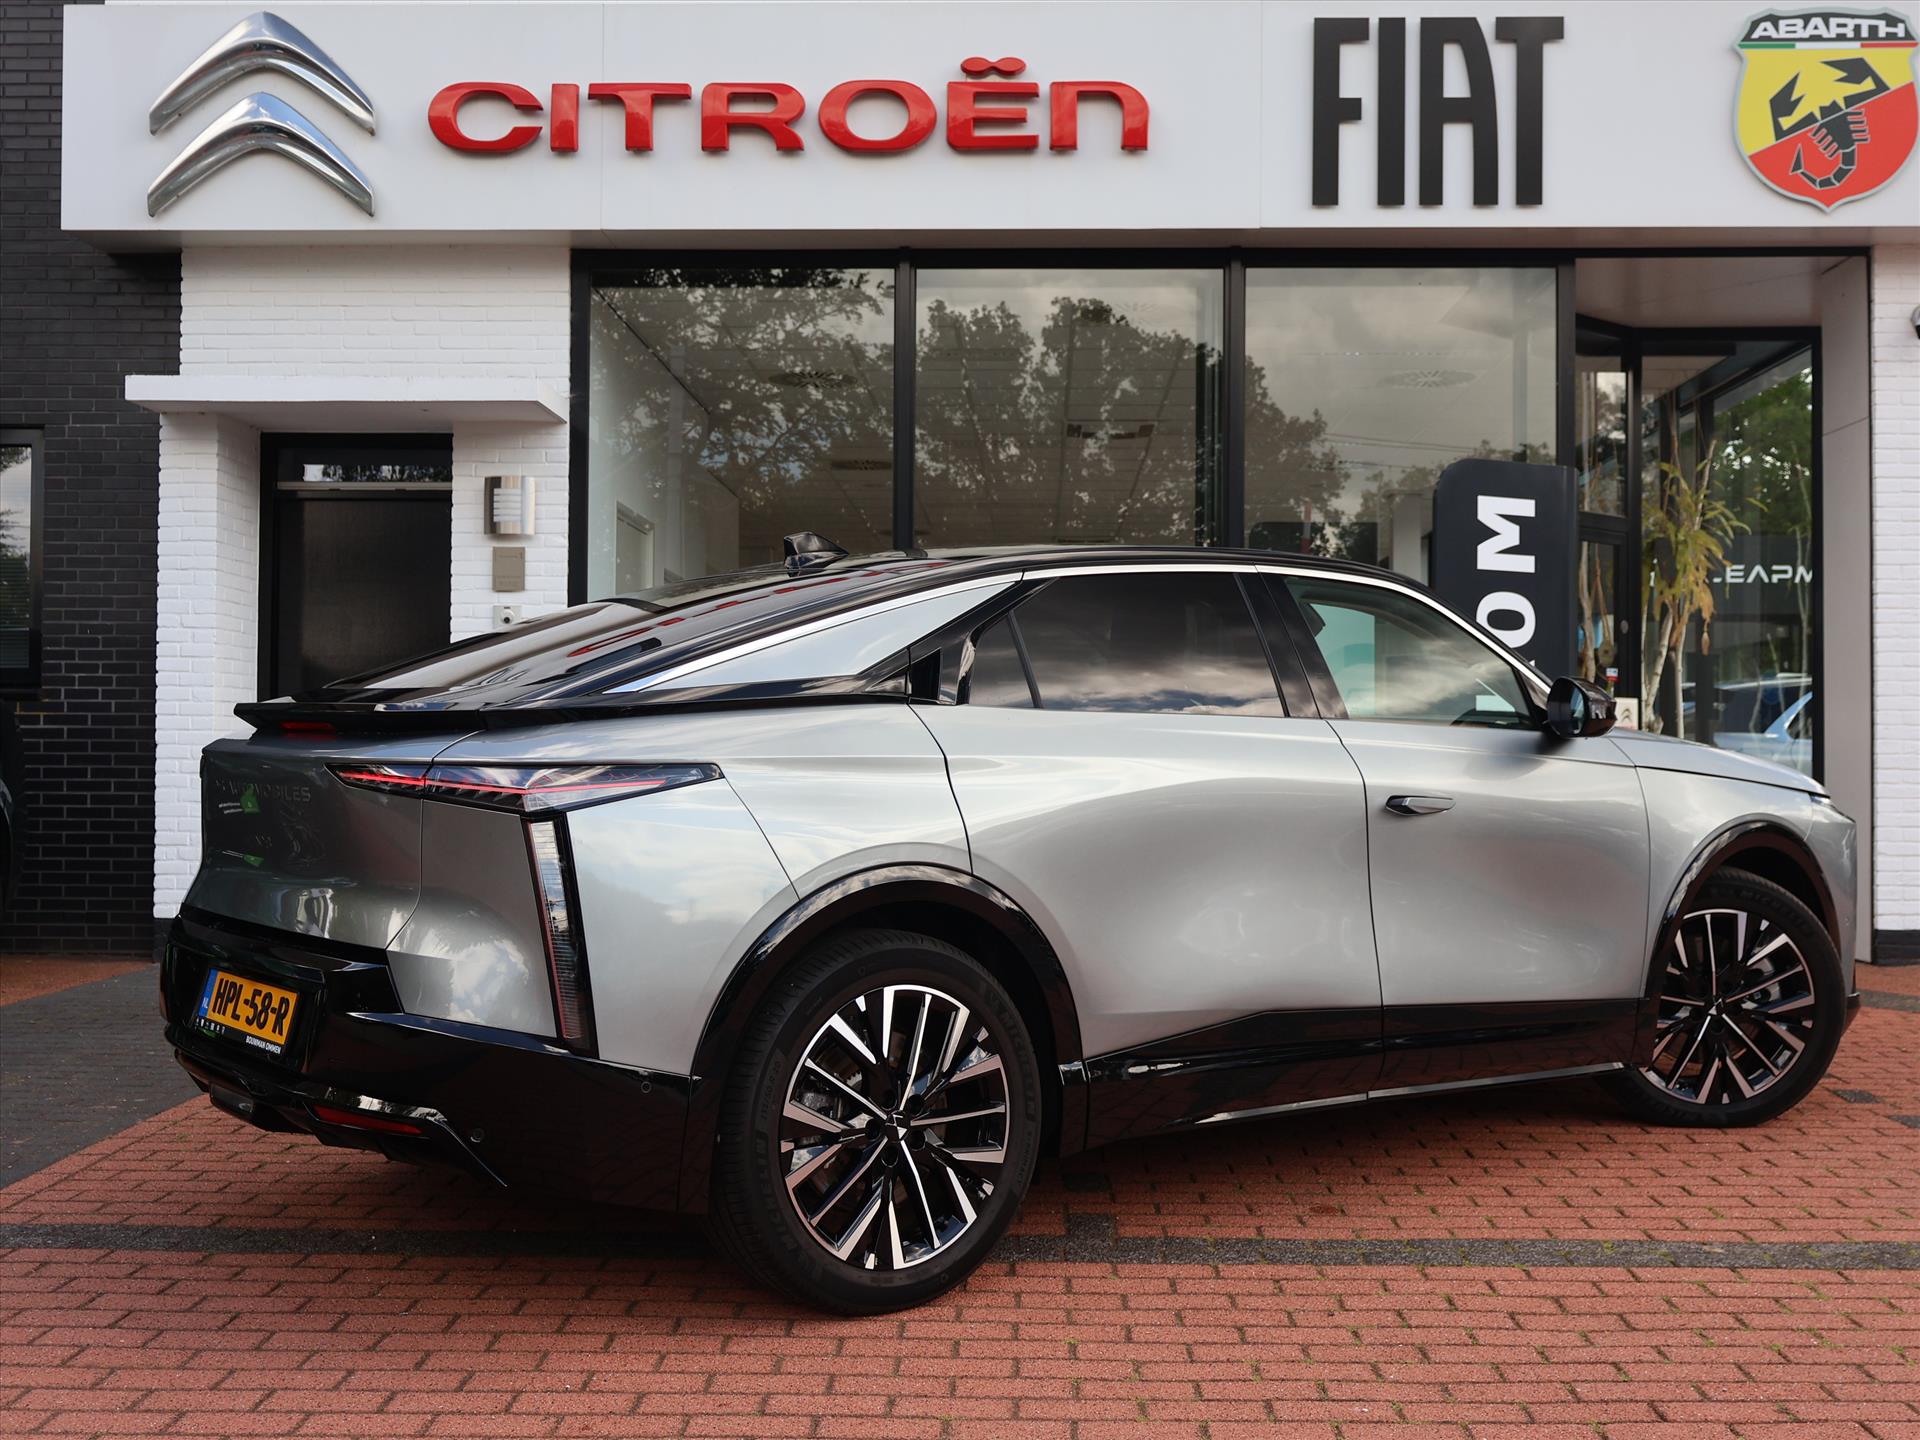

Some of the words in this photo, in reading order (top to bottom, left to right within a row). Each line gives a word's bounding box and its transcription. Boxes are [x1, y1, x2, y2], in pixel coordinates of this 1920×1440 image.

[1751, 17, 1905, 39] ABARTH
[1312, 16, 1564, 206] FIAT
[212, 978, 290, 1036] HPL-58-R
